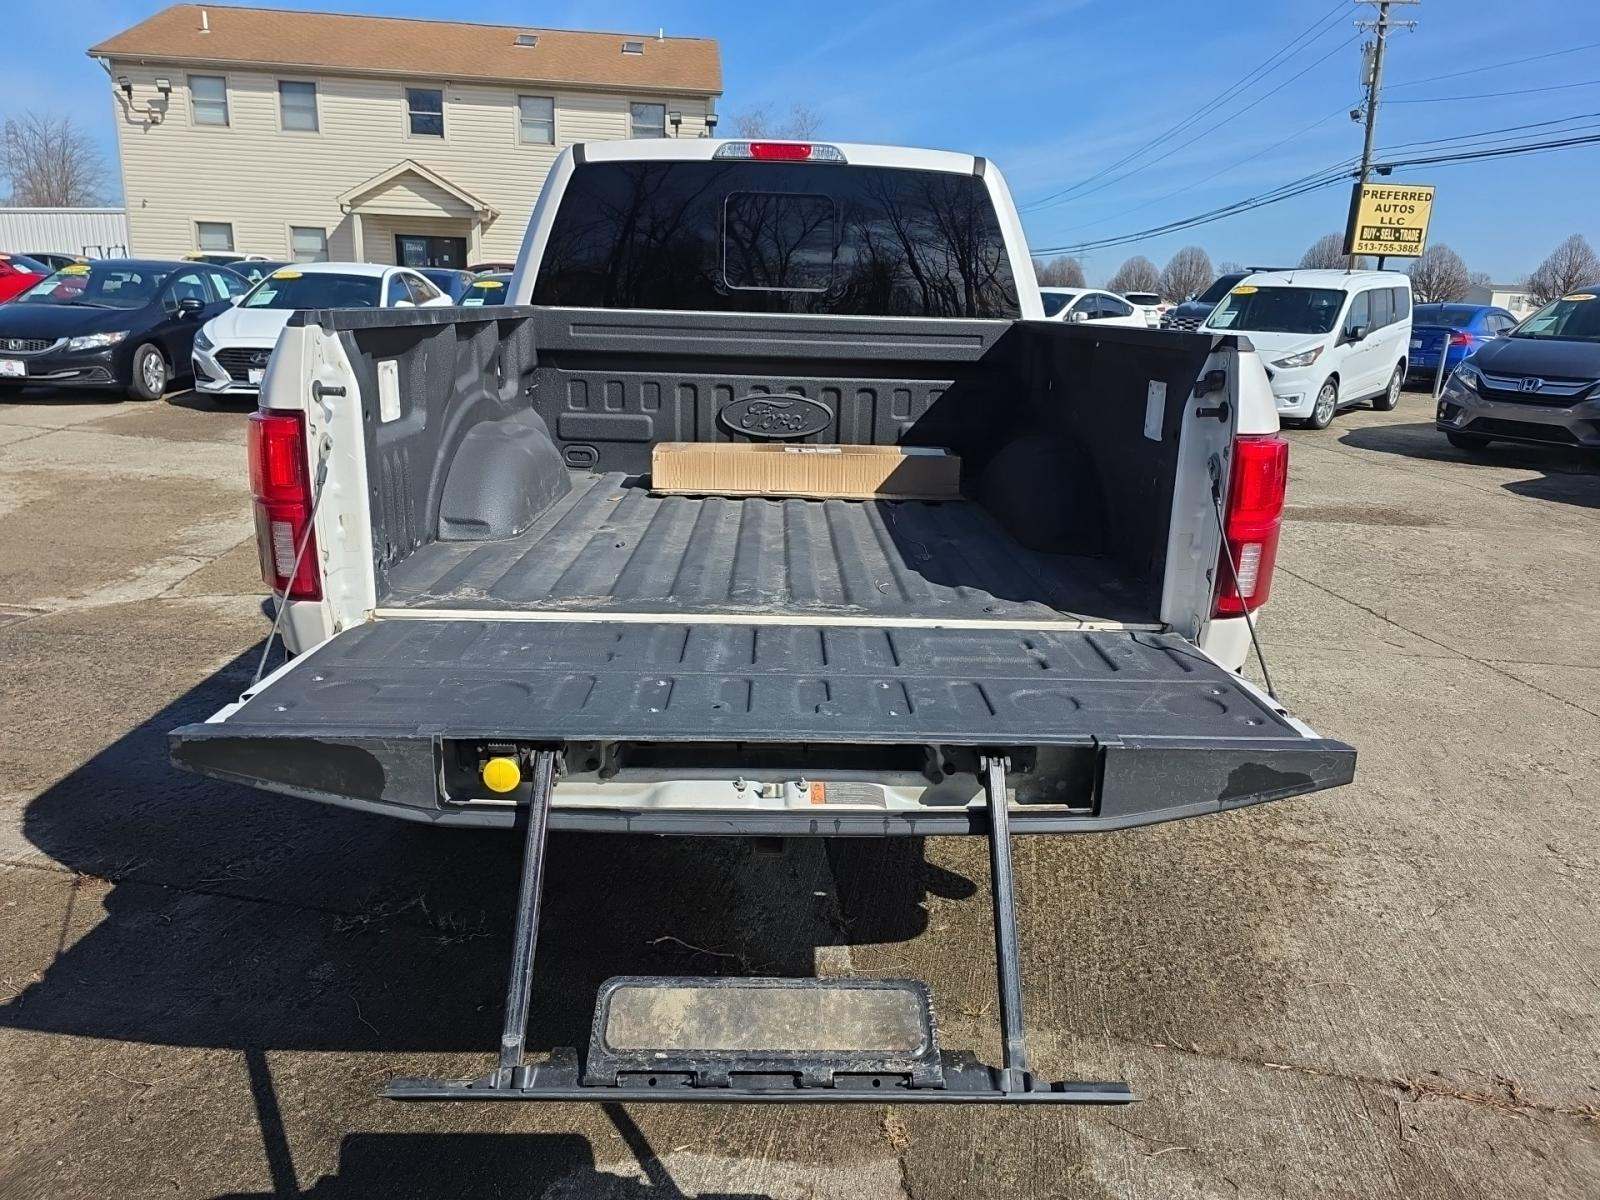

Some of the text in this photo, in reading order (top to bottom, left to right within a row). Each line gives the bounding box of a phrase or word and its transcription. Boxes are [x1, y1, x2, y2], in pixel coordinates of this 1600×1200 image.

[1362, 190, 1432, 202] PREFERRED
[1374, 204, 1415, 214] AUTOS
[1380, 217, 1405, 225] LLC
[740, 398, 809, 430] Ford
